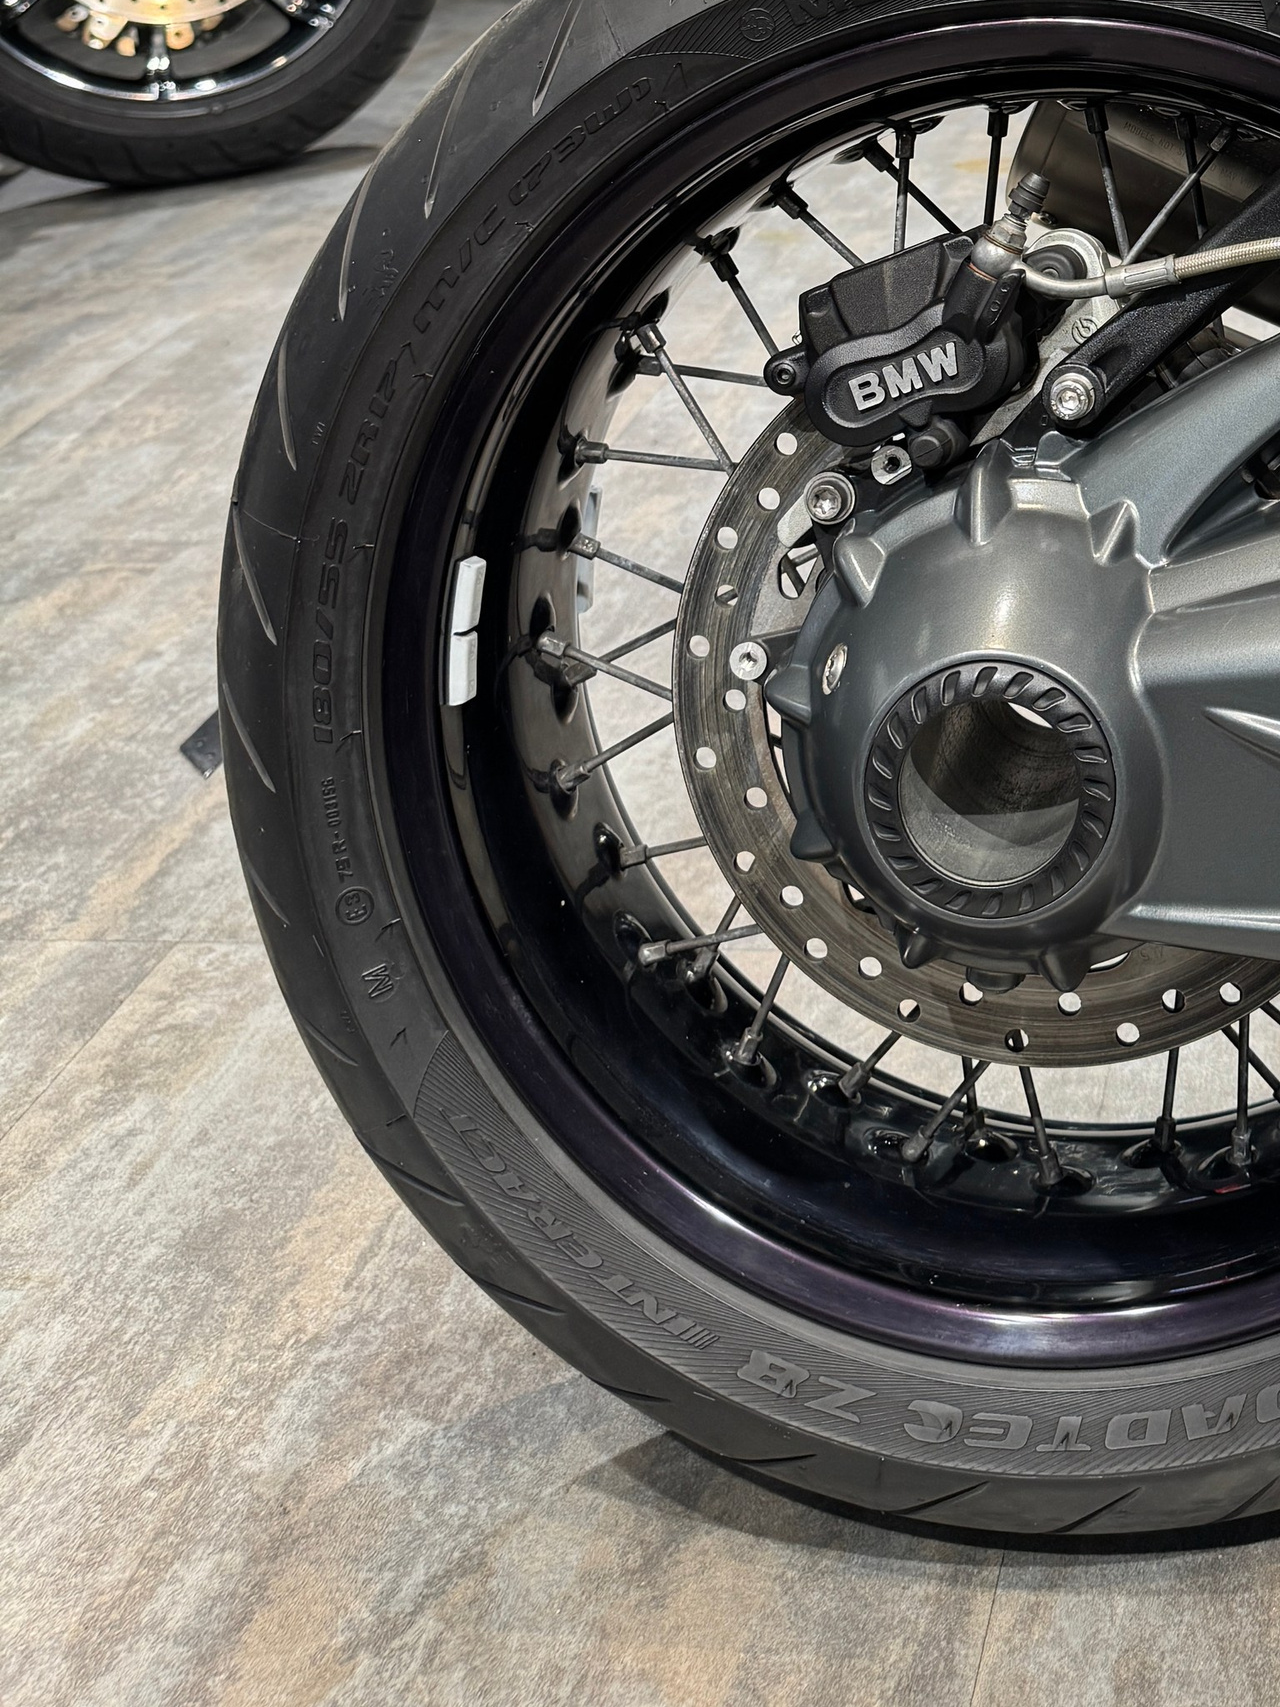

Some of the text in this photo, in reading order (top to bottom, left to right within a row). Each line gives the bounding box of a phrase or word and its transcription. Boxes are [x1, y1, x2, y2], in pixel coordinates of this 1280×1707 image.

[848, 342, 959, 412] BMW
[312, 517, 349, 744] 180/55
[338, 359, 398, 506] ZR17
[413, 203, 506, 334] M/C
[437, 1107, 719, 1350] INTERACT
[737, 1349, 878, 1424] Z8
